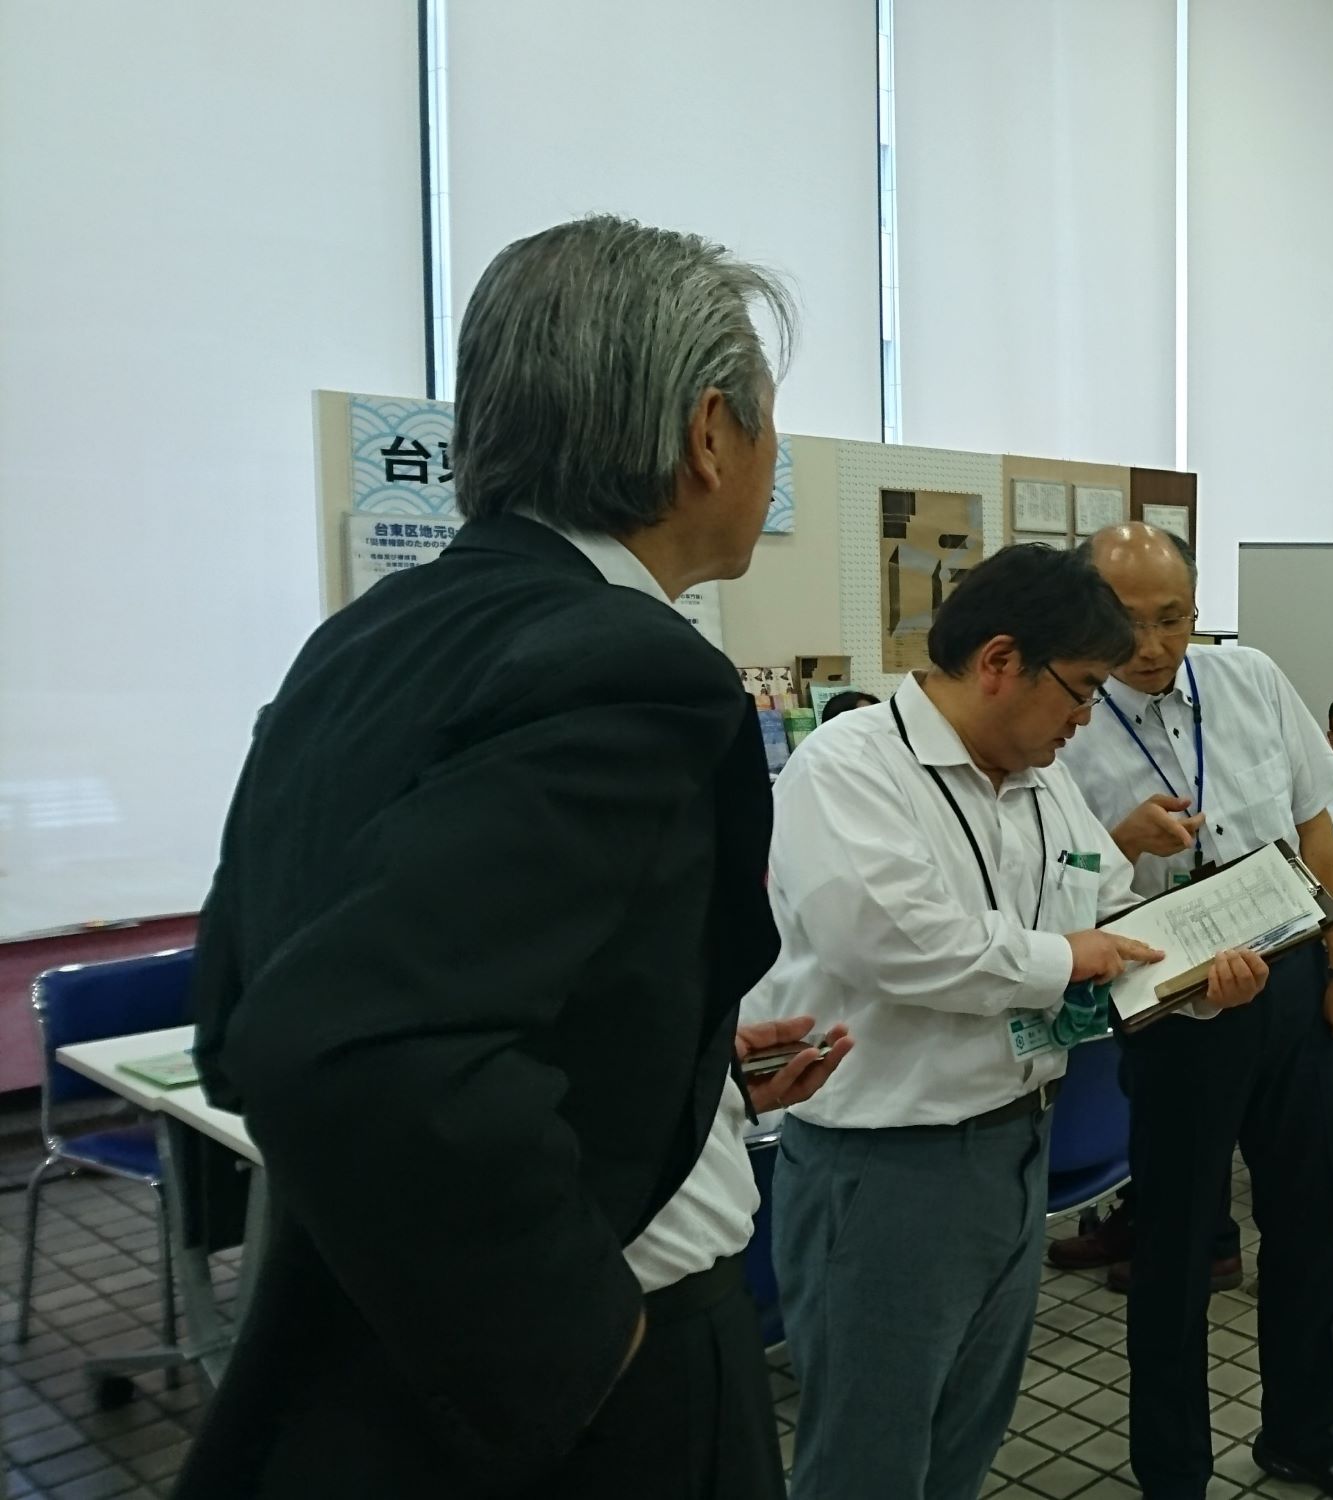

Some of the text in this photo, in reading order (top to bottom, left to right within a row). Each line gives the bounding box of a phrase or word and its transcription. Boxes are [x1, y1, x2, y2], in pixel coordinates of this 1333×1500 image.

[374, 522, 459, 539] 台東区地元9
